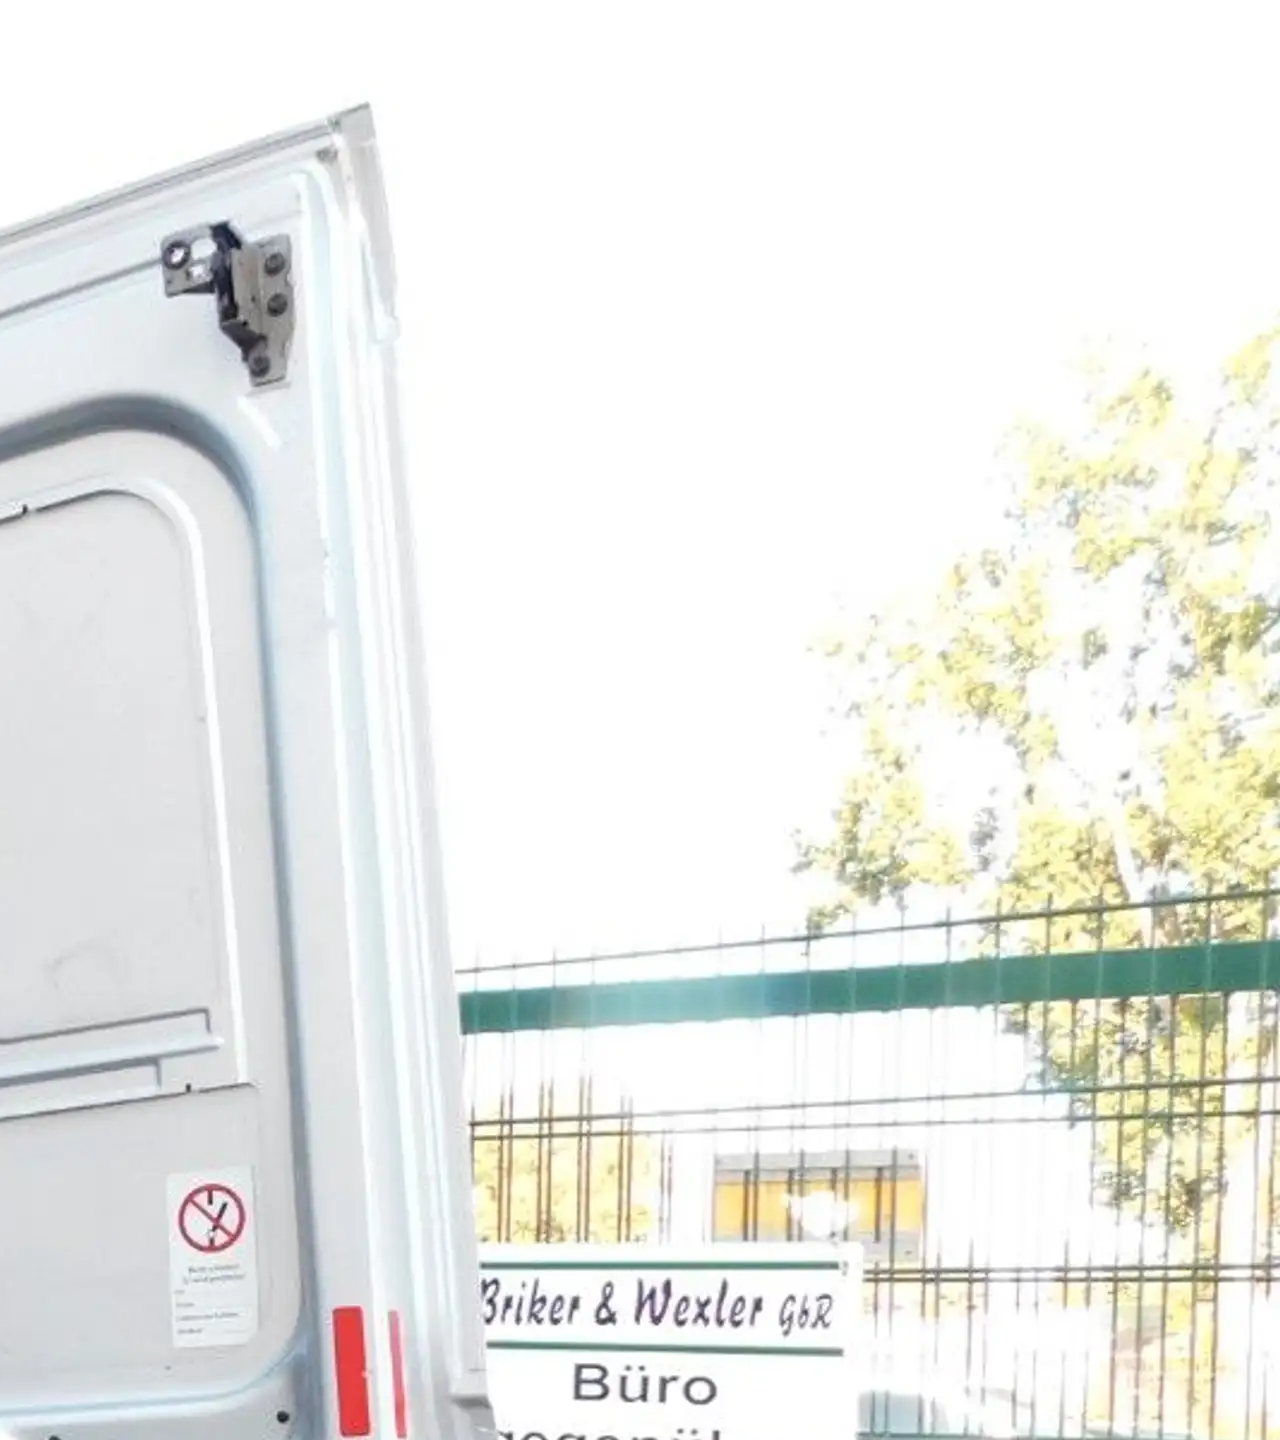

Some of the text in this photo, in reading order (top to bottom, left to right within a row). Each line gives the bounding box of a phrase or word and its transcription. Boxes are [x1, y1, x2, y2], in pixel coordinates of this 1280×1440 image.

[481, 1277, 833, 1337] Briker & Wexler GbR
[573, 1362, 718, 1406] Büro
